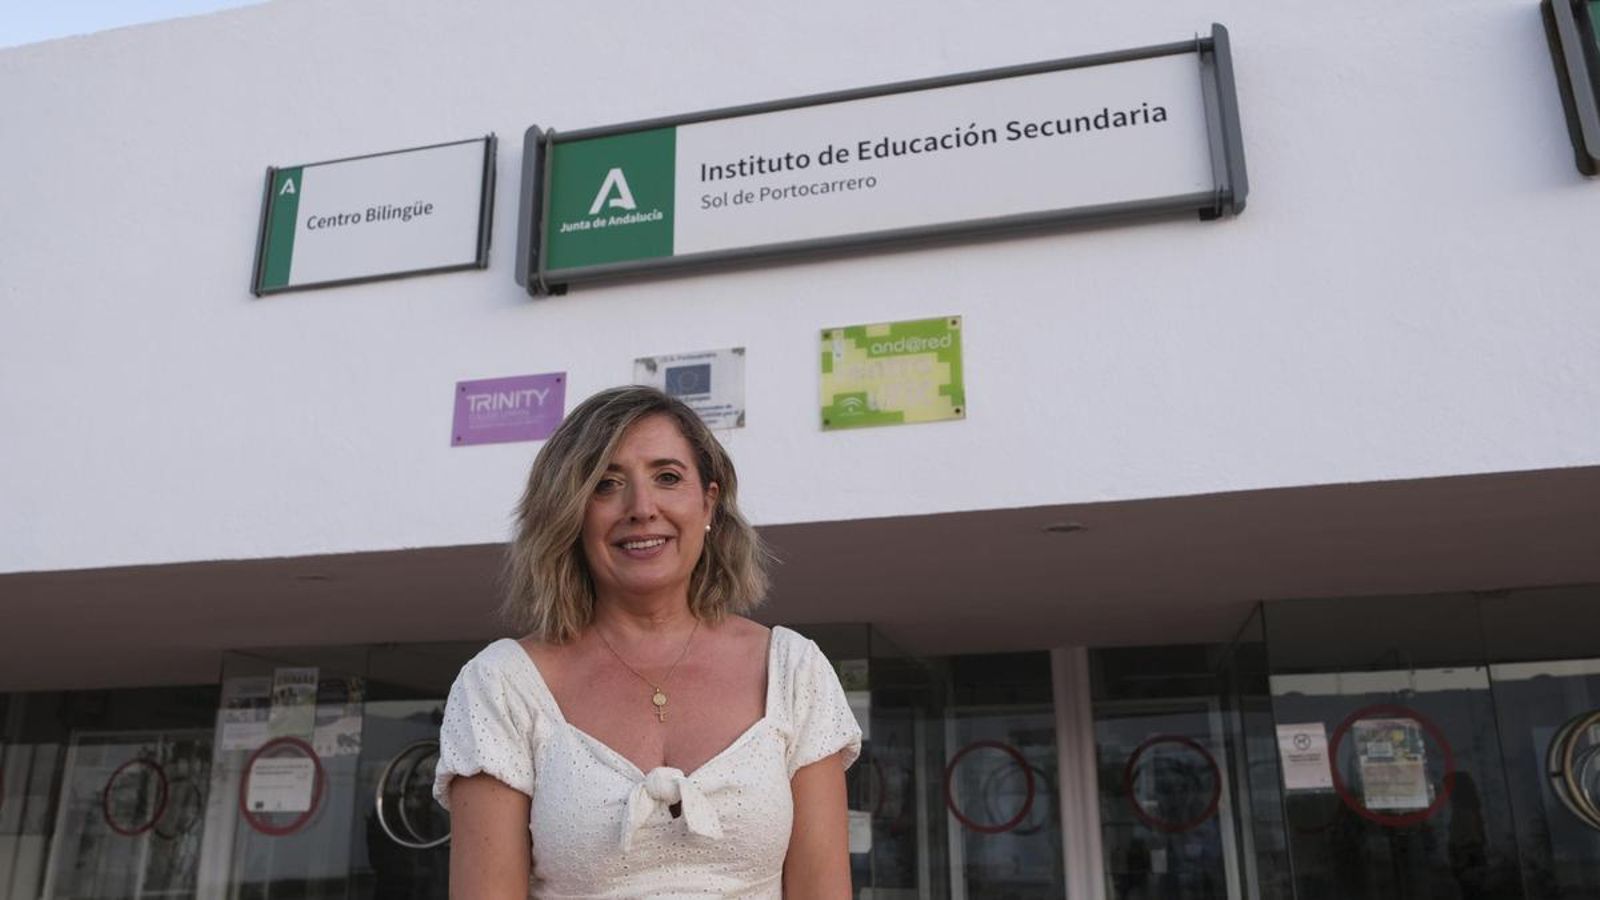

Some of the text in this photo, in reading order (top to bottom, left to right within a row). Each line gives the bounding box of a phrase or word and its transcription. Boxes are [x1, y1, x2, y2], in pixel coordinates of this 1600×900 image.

[700, 102, 1168, 182] Instituto de Educación Secundaria
[701, 175, 877, 210] Sol de Portocarrero
[306, 200, 434, 231] Centro Bilingüe
[560, 209, 663, 233] Junta de Andalucía
[871, 332, 952, 355] and@red
[466, 387, 550, 413] TRINITY
